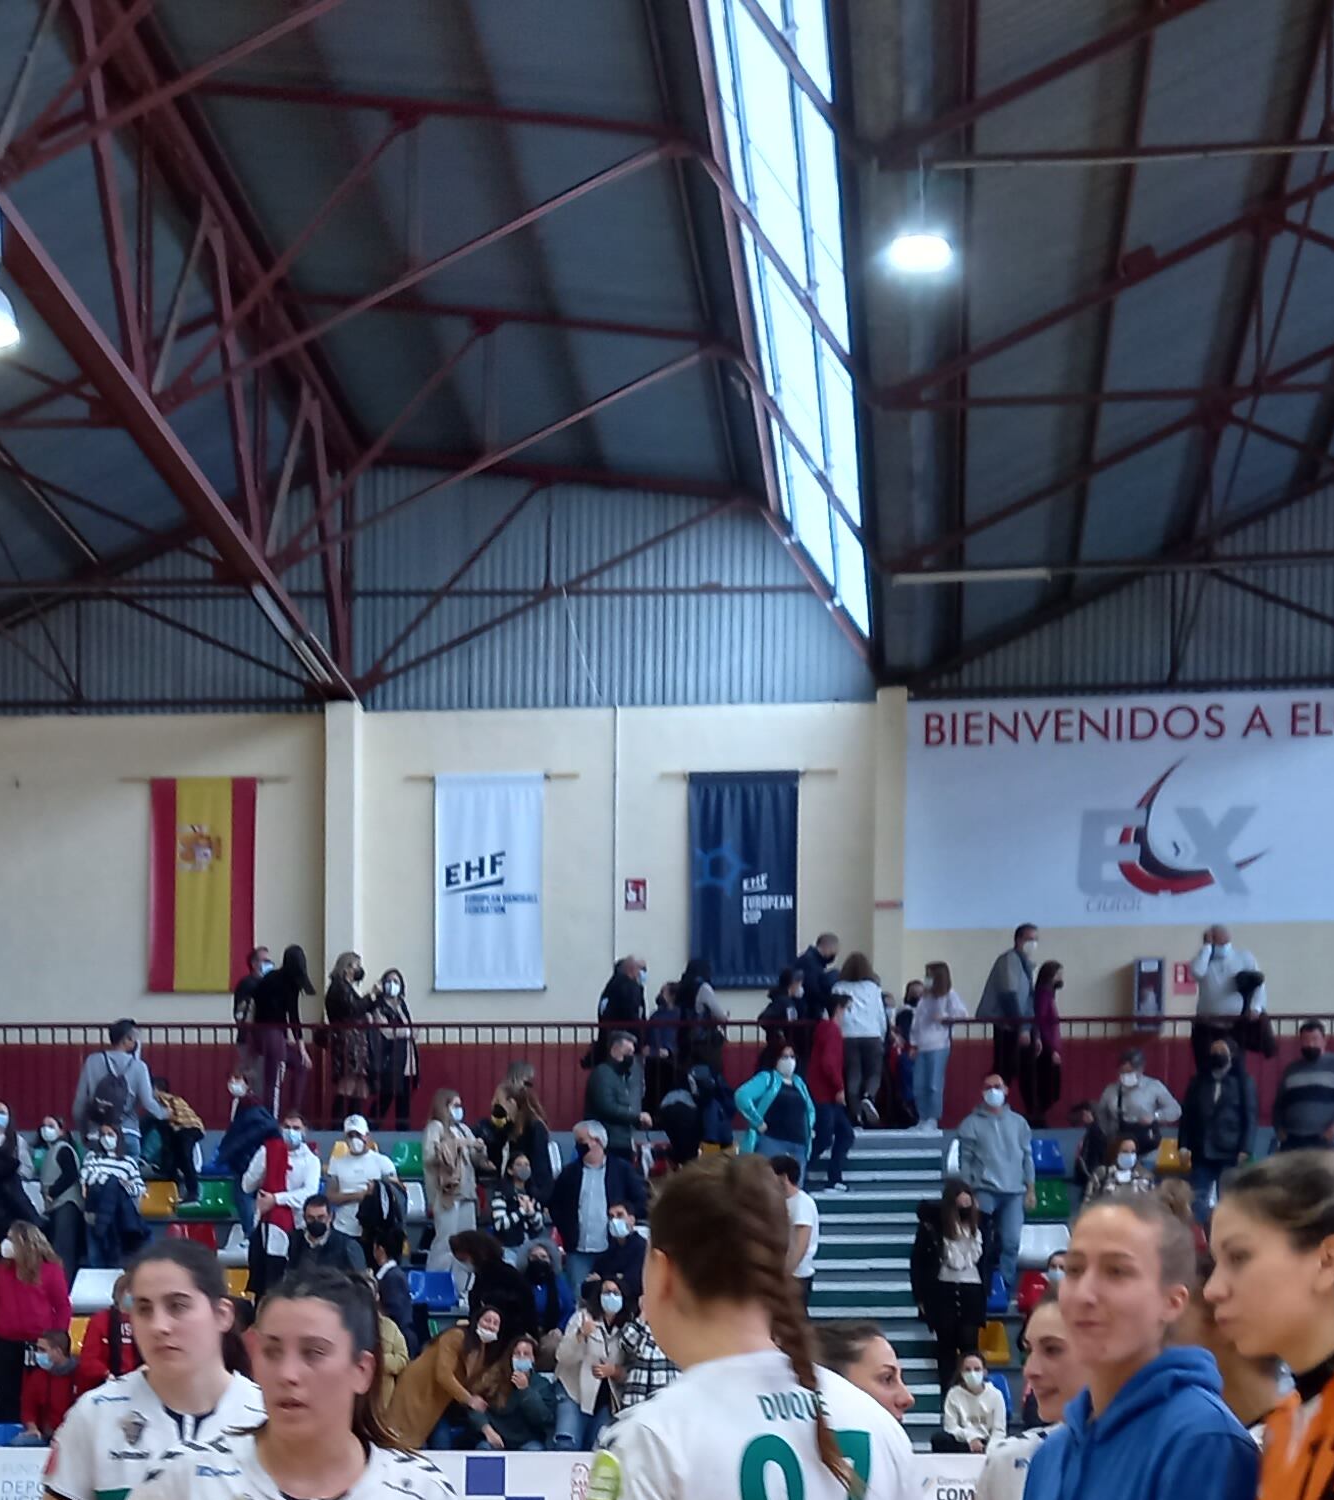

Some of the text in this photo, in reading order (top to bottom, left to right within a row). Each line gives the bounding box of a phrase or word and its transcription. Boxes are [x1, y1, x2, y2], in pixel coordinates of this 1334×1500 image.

[923, 703, 1226, 748] BIENVENIDOS
[1240, 707, 1273, 739] A
[445, 850, 506, 880] EHF
[742, 894, 793, 911] EUROPEAN
[742, 911, 762, 926] CUP
